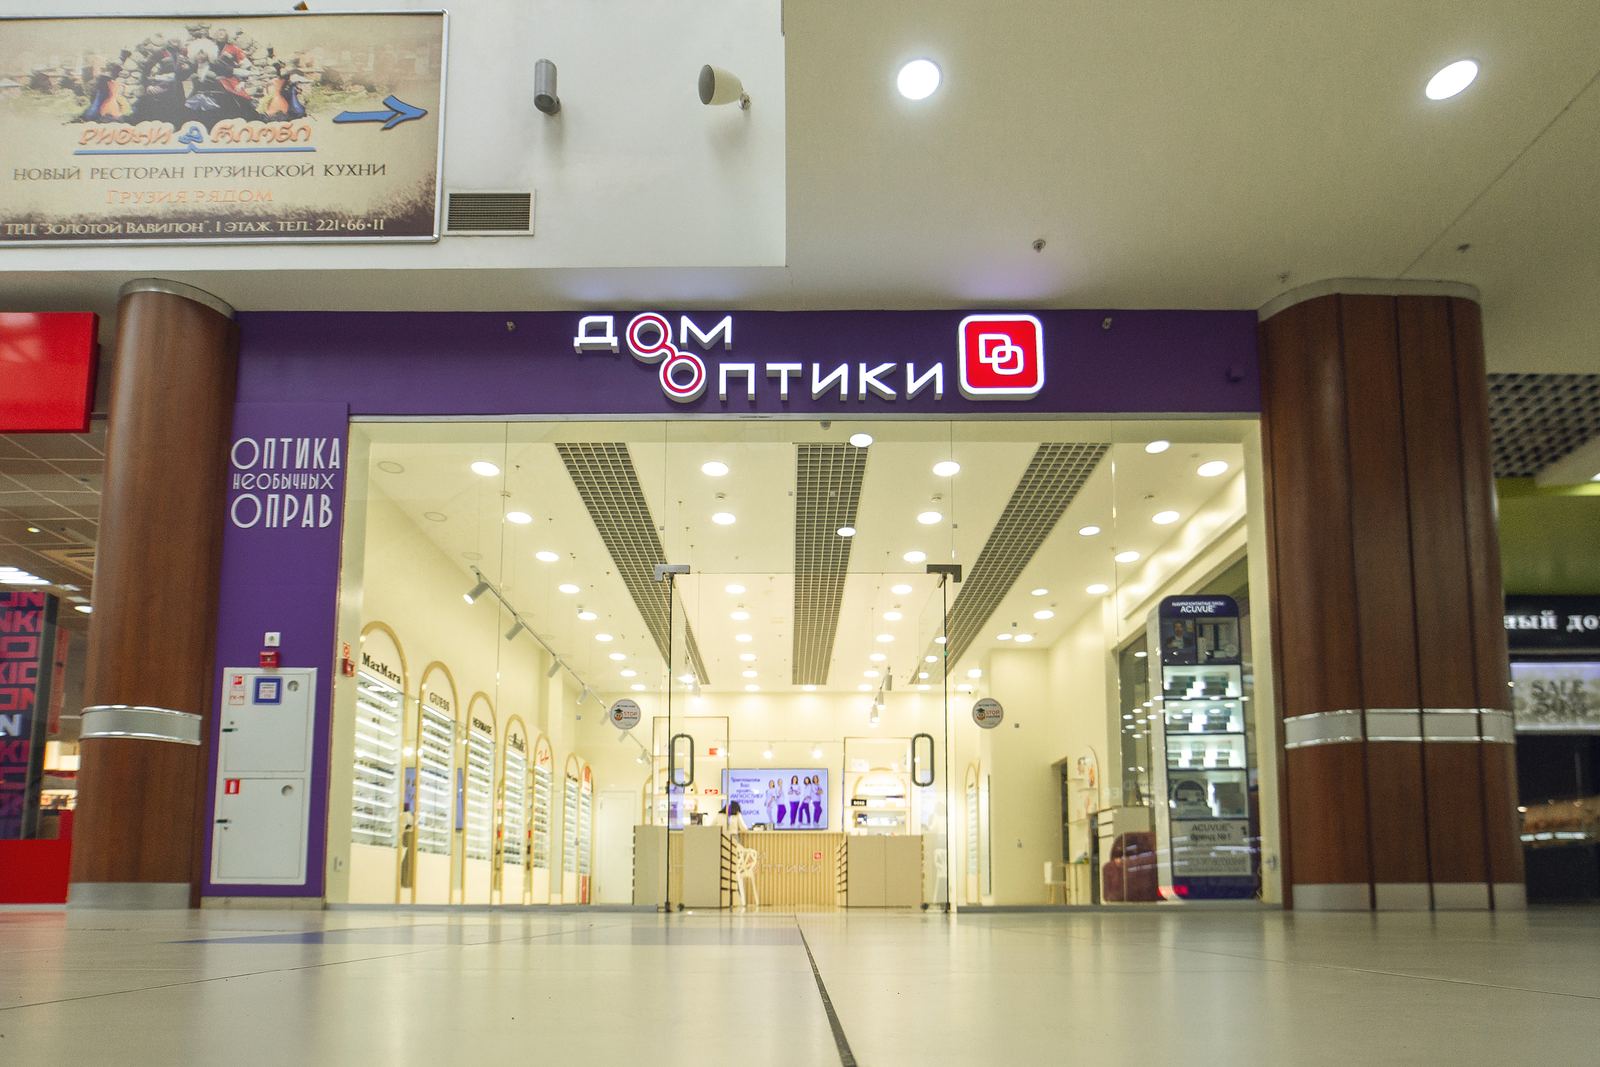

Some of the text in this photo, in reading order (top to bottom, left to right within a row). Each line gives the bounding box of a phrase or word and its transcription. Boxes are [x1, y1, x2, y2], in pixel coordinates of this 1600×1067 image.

[13, 162, 386, 181] НОВЫЙ РЕСТОРАН ГРУЗИНСКОЙ КУХНИ
[106, 189, 273, 205] ГРУЗИЯ РЯДОМ
[5, 223, 37, 236] ТРЦ
[574, 312, 733, 366] ДОМ
[658, 349, 945, 403] ОПТИКИ
[230, 437, 341, 470] ОПТИКА
[230, 493, 334, 529] ОПРАВ
